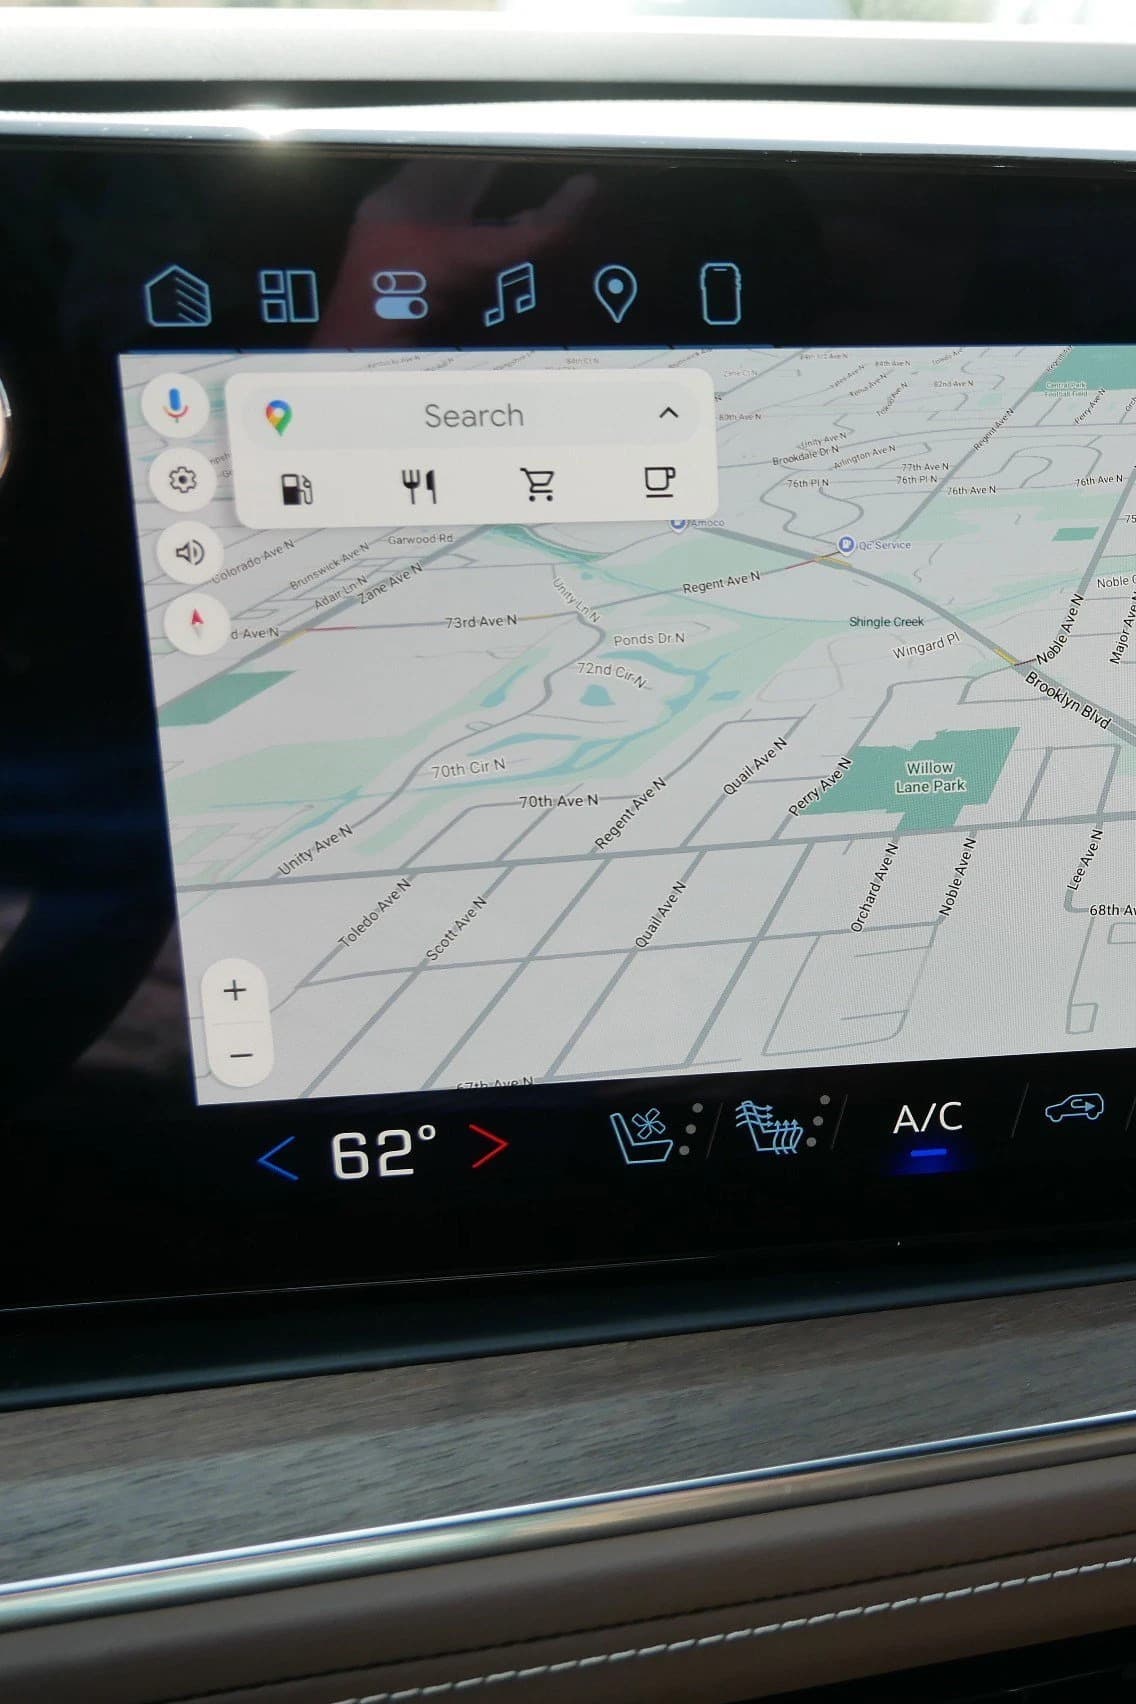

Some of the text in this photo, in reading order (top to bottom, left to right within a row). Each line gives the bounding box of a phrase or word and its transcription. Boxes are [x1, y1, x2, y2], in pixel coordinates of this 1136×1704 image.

[426, 404, 524, 428] Search
[902, 463, 921, 471] 77th
[924, 463, 941, 471] Ave
[1076, 478, 1094, 487] 76th
[1096, 476, 1115, 485] Ave
[388, 533, 453, 545] Garwood Rd
[860, 540, 911, 550] Qc Service
[359, 563, 422, 605] Zane Ave N
[683, 571, 760, 594] Regent Ave N
[1098, 577, 1129, 588] Noble
[446, 614, 517, 628] 73rd Ave N
[850, 616, 924, 628] Shingle Creek
[1037, 593, 1084, 665] Noble Ave N
[614, 633, 684, 646] Ponds Dr N
[894, 632, 960, 659] Wingard Pl
[1110, 630, 1130, 664] Major
[578, 662, 646, 689] 72nd Cir N
[1026, 671, 1112, 730] Brooklyn Blvd
[432, 758, 506, 778] 70th Cir N
[723, 736, 787, 796] Quail Ave N
[908, 762, 953, 774] Willow
[789, 756, 852, 817] Perry Ave N
[896, 780, 965, 794] Lane Park
[520, 794, 599, 808] 70th Ave N
[595, 776, 667, 850] Regent Ave N
[278, 823, 353, 877] Unity Ave N
[1068, 829, 1103, 891] Lee Ave N
[852, 842, 899, 932] Orchard Ave N
[939, 838, 976, 916] Noble Ave N
[338, 878, 411, 948] Toledo Ave N
[636, 880, 687, 949] Quail Ave N
[1090, 905, 1120, 916] 68th
[426, 896, 488, 961] Scott Ave N
[893, 1102, 963, 1134] A/C
